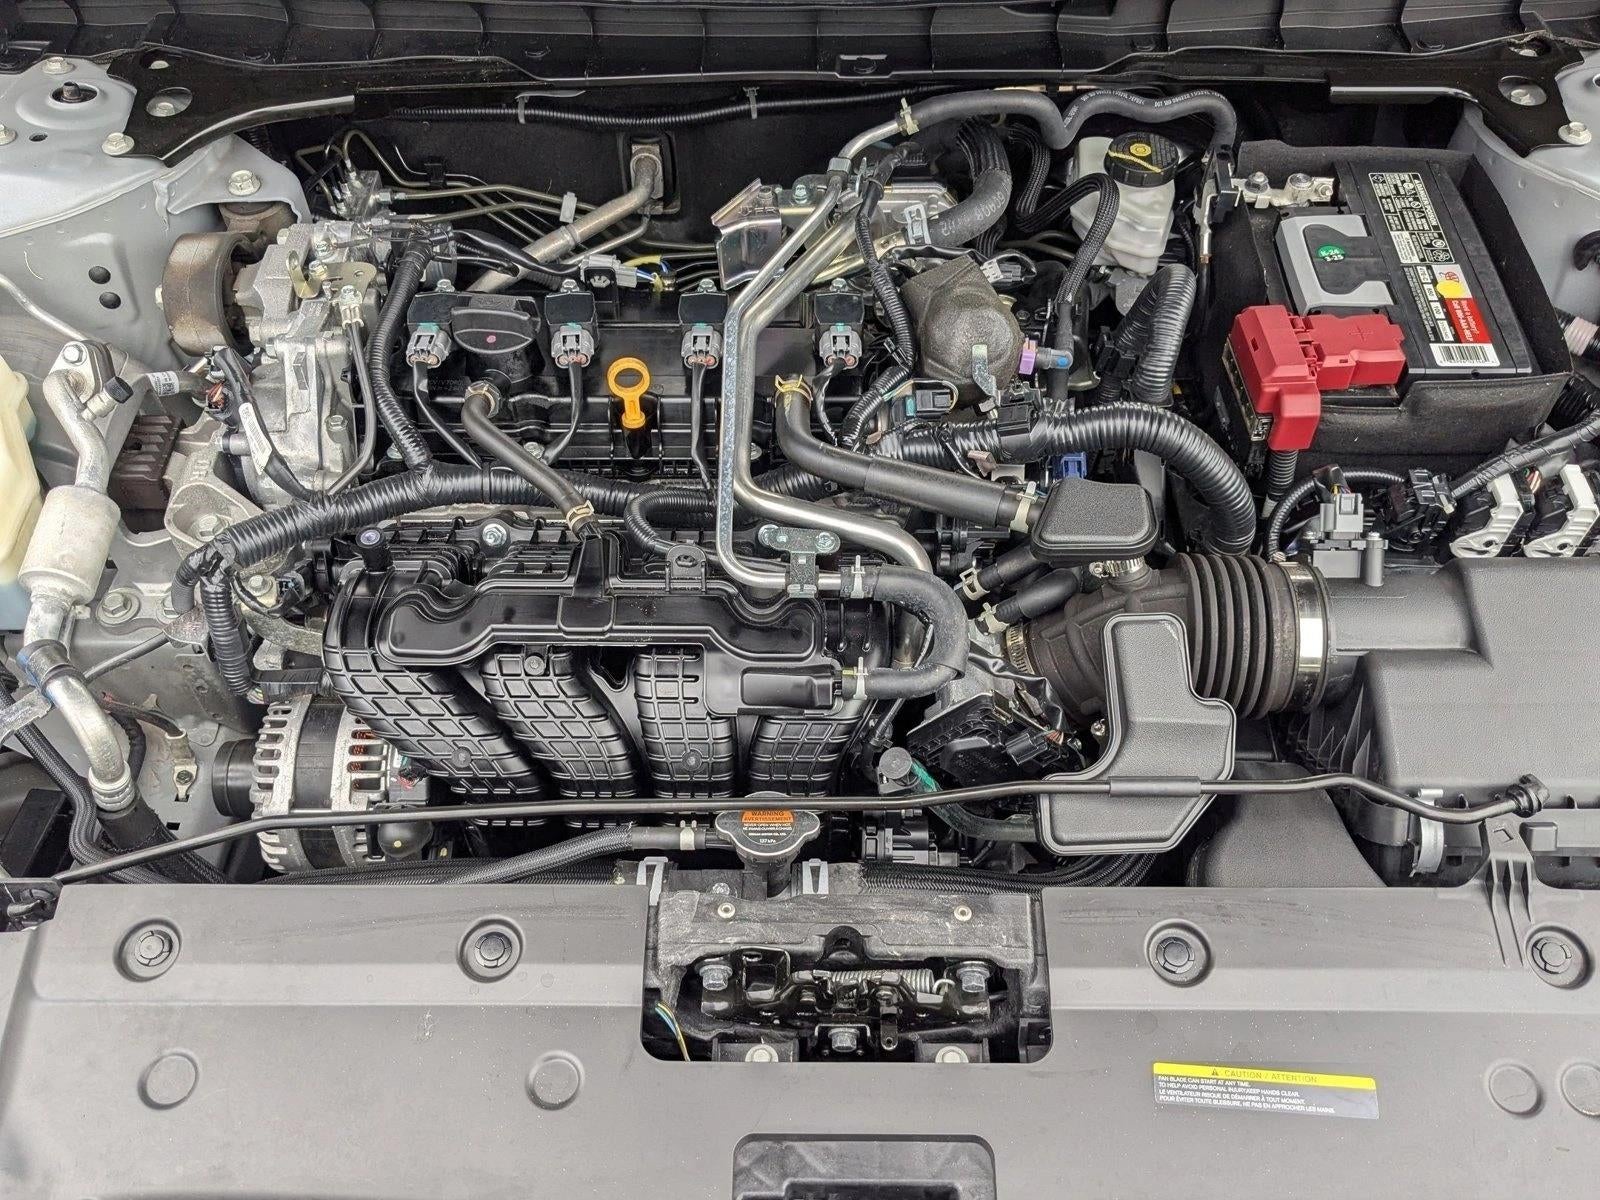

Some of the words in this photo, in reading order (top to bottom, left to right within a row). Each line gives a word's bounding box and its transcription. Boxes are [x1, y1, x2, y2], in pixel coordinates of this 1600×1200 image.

[1224, 1069, 1261, 1079] CAUTION
[1270, 1073, 1317, 1083] ATTENTION
[1198, 1084, 1227, 1092] PERSONAL
[1166, 1088, 1200, 1097] VENTILATEUR
[1266, 1095, 1279, 1103] TOUT
